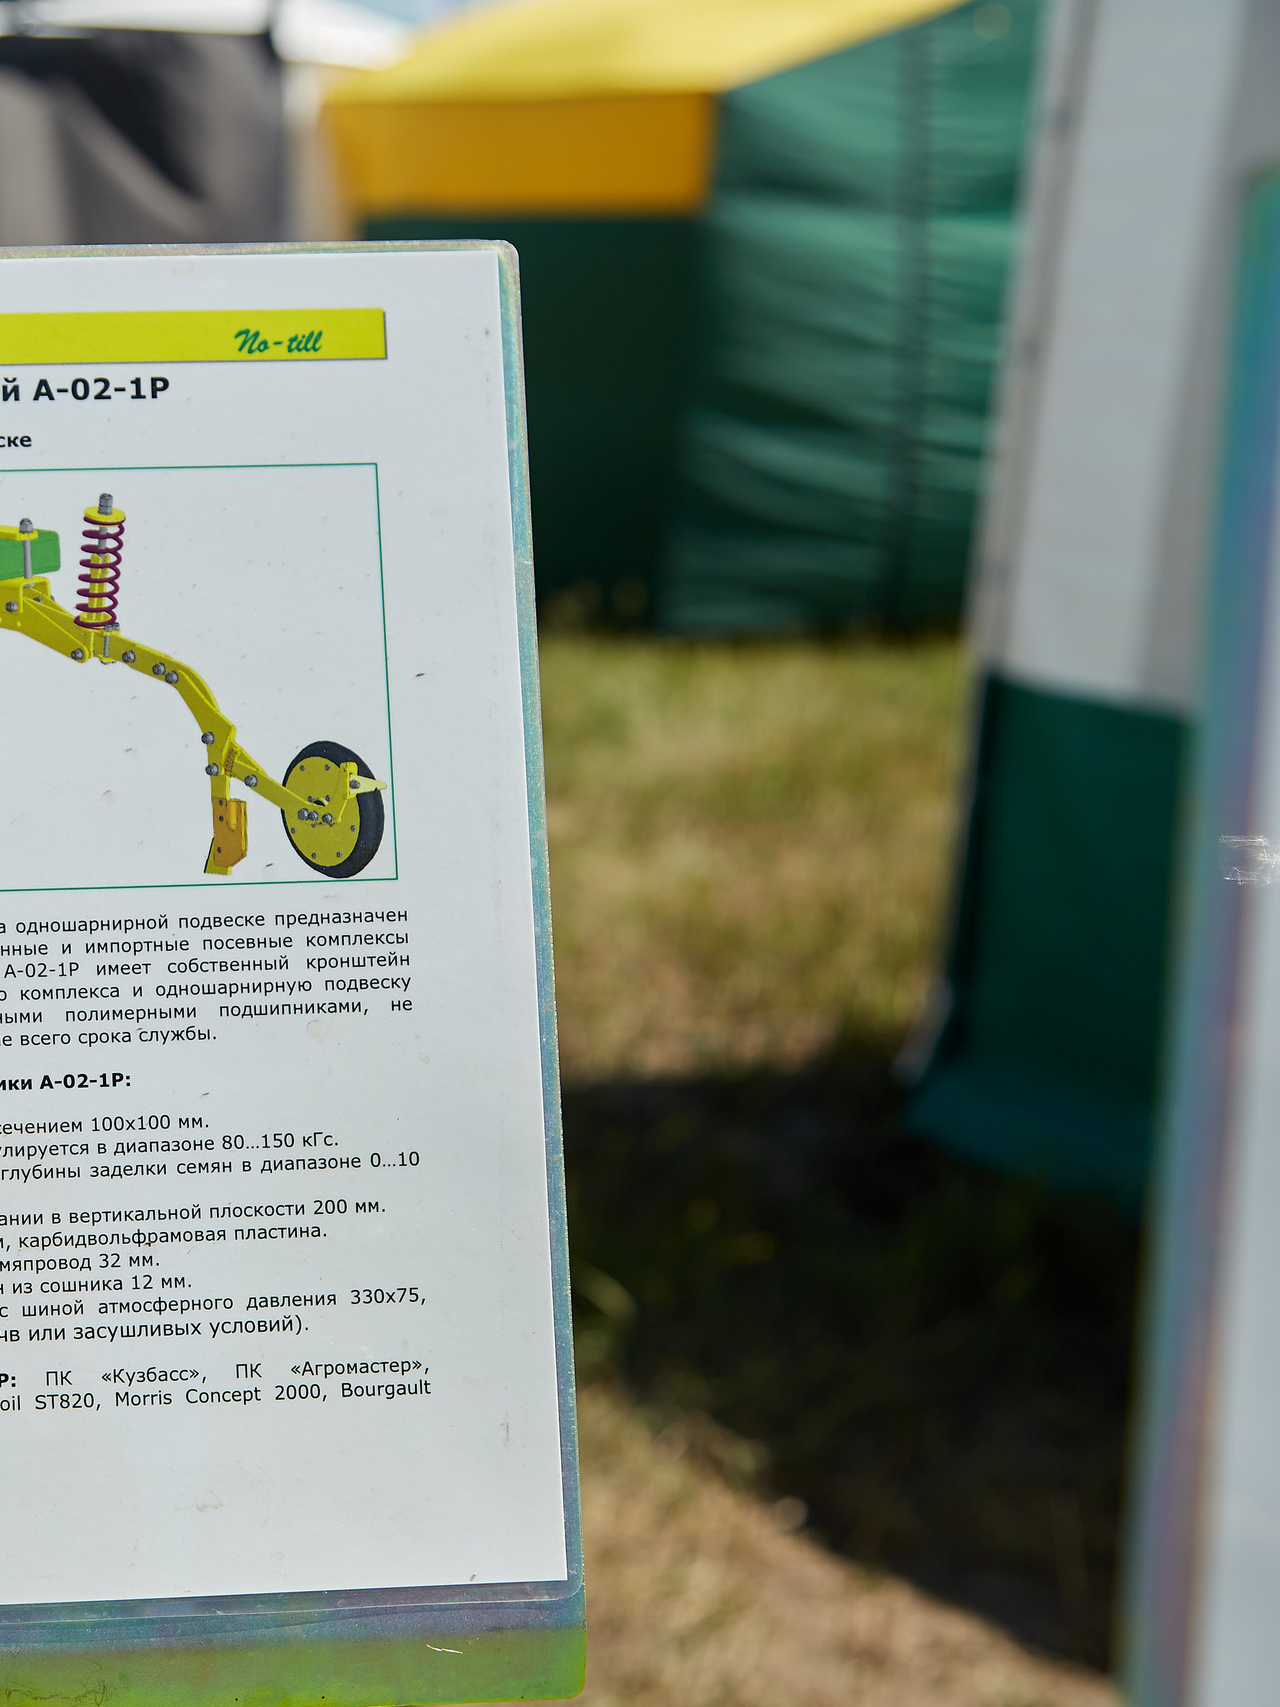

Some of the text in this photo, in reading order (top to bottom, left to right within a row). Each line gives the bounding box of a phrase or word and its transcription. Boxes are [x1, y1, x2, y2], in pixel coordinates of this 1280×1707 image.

[234, 328, 323, 354] No-till
[15, 913, 169, 936] одношарнирной
[178, 914, 266, 931] подвеске
[274, 910, 408, 930] предназначен
[61, 942, 72, 955] и
[85, 937, 190, 957] импортные
[202, 935, 294, 951] посевные
[305, 932, 409, 948] комплексы
[96, 962, 152, 977] имеет
[167, 954, 289, 974] собственный
[306, 950, 410, 973] кронштейн
[19, 986, 120, 1001] комплекса
[132, 985, 143, 998] и
[155, 979, 313, 1000] одношарнирную
[324, 976, 412, 994] подвеску
[65, 1006, 197, 1024] полимерными
[219, 1000, 369, 1020] подшипниками,
[390, 999, 413, 1012] не
[19, 1032, 72, 1047] всего
[77, 1031, 132, 1048] срока
[137, 1024, 217, 1046] службы.
[178, 1116, 209, 1130] мм.
[96, 1142, 108, 1155] в
[113, 1138, 215, 1157] диапазоне
[302, 1131, 339, 1148] кГс.
[0, 1161, 81, 1184] глубины
[89, 1163, 167, 1180] заделки
[176, 1160, 233, 1175] семян
[241, 1160, 253, 1173] в
[259, 1156, 362, 1175] диапазоне
[51, 1212, 62, 1225] в
[68, 1203, 202, 1227] вертикальной
[209, 1201, 306, 1219] плоскости
[313, 1198, 348, 1216] 200
[355, 1200, 386, 1214] мм.
[17, 1228, 227, 1248] карбидвольфрамовая
[234, 1225, 327, 1241] пластина.
[98, 1252, 122, 1269] 32
[126, 1252, 160, 1268] мм.
[12, 1281, 33, 1295] из
[39, 1278, 124, 1294] сошника
[131, 1273, 154, 1291] 12
[160, 1276, 192, 1290] мм.
[21, 1298, 84, 1318] шиной
[97, 1295, 234, 1316] атмосферного
[245, 1293, 337, 1312] давления
[28, 1327, 66, 1342] или
[73, 1322, 202, 1343] засушливых
[208, 1314, 309, 1339] условий).
[45, 1368, 74, 1387] ПК
[235, 1362, 263, 1380] ПК
[34, 1392, 101, 1412] ST820,
[115, 1389, 173, 1408] Morris
[185, 1386, 262, 1406] Concept
[274, 1383, 328, 1403] 2000,
[341, 1378, 432, 1400] Bourgault
